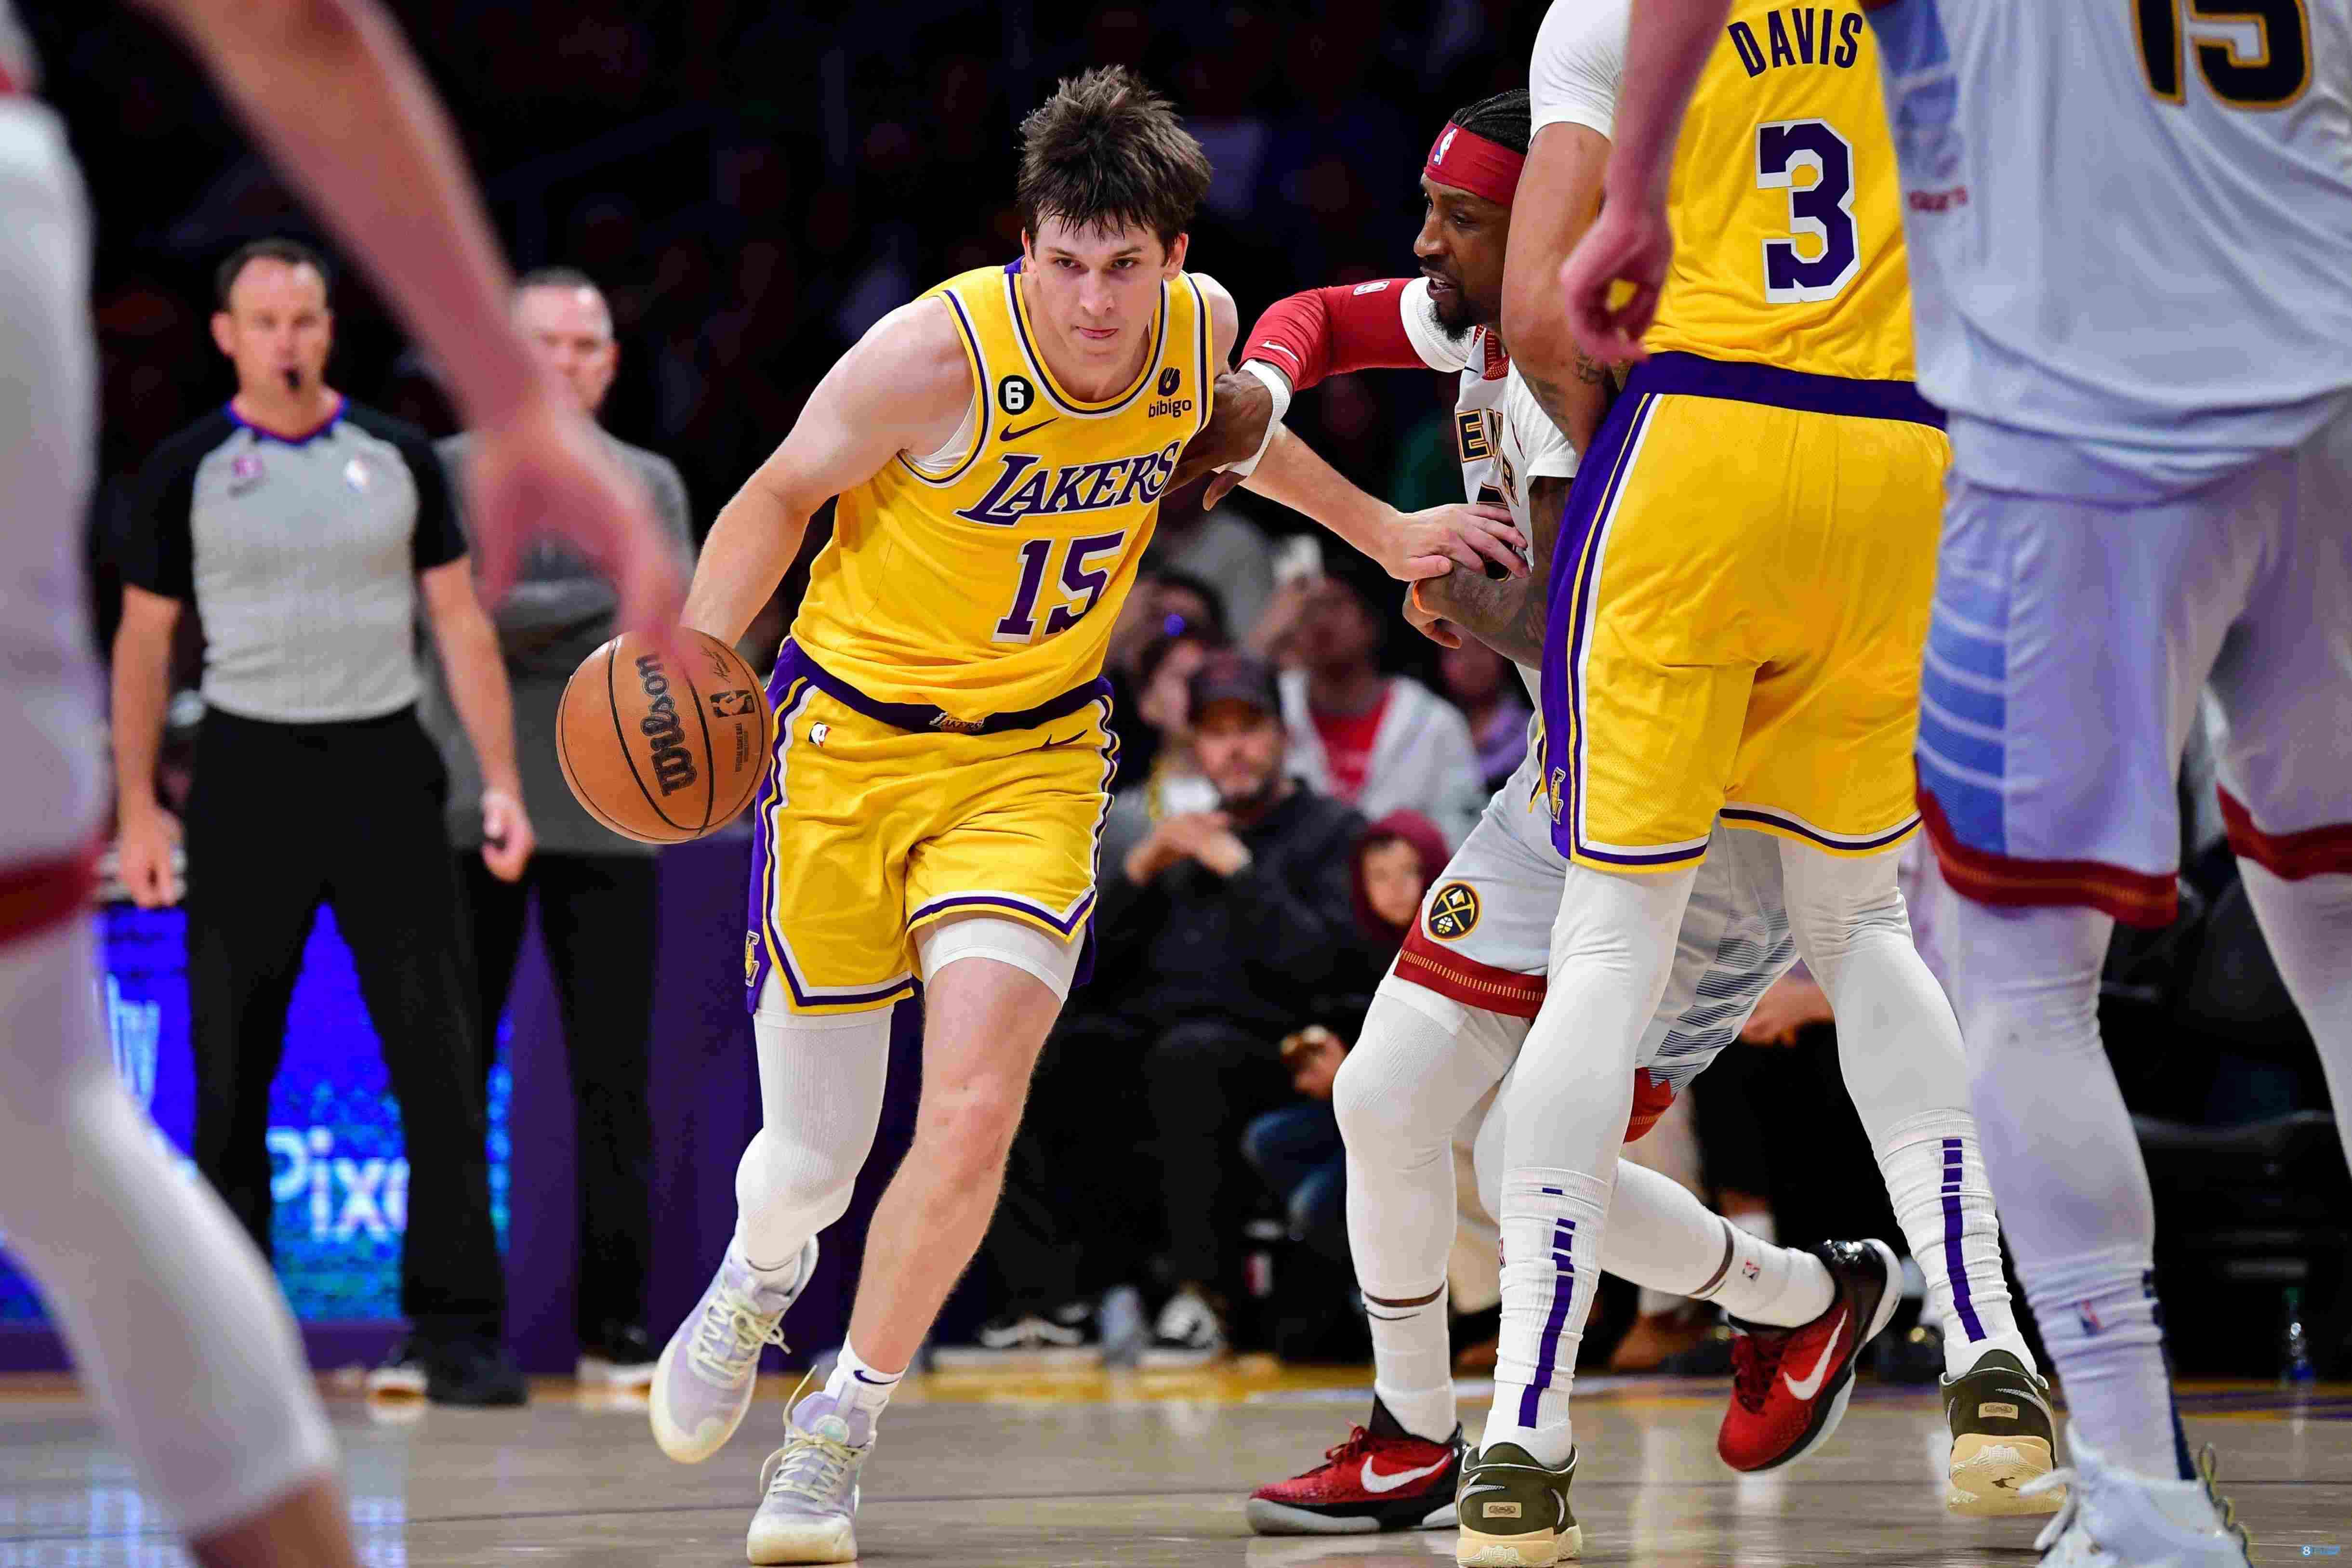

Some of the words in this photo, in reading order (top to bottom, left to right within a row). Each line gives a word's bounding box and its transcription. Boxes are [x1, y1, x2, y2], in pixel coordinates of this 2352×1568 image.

[1728, 8, 1863, 78] DAVIS
[1756, 118, 1861, 304] 3
[1005, 381, 1025, 410] 6
[1149, 398, 1192, 418] bibigo
[952, 440, 1183, 527] LAKERS
[991, 529, 1126, 643] 15
[635, 652, 698, 797] Wilson
